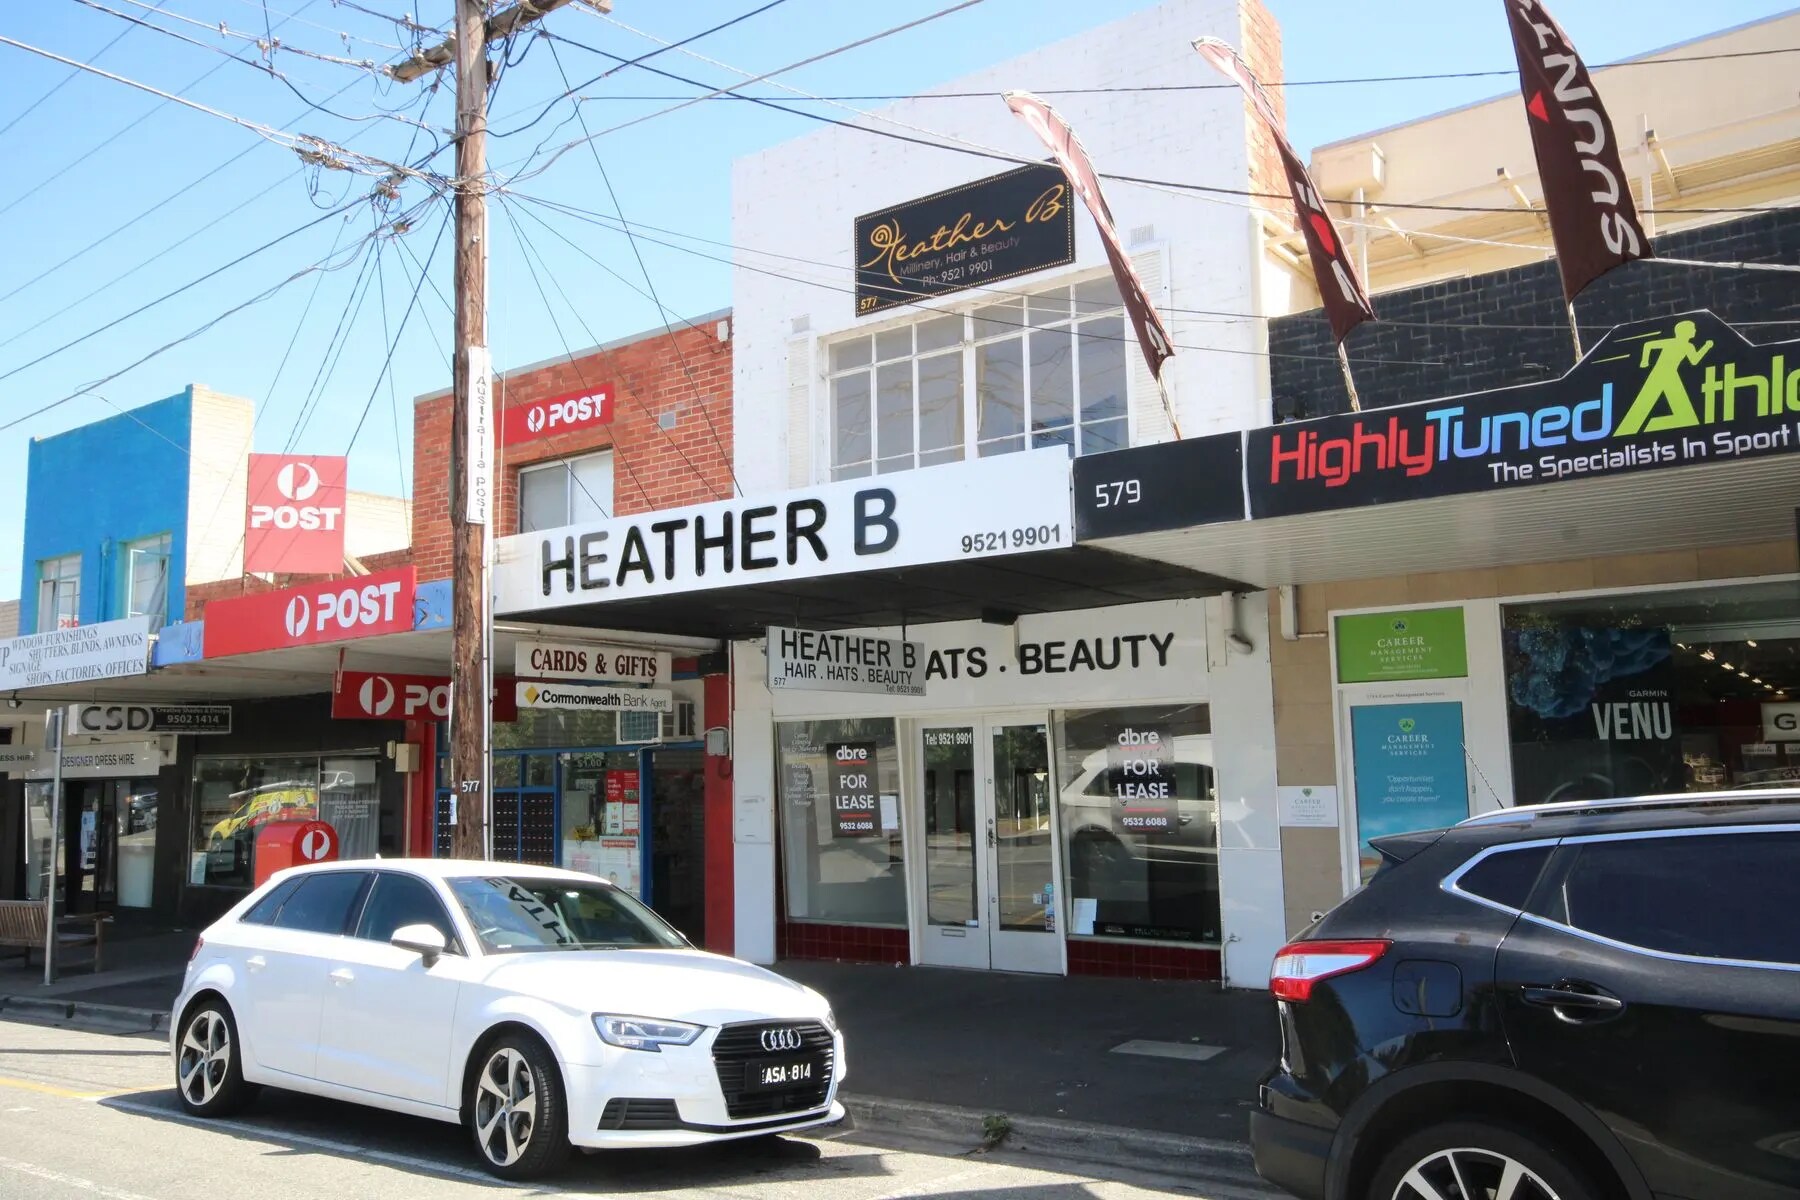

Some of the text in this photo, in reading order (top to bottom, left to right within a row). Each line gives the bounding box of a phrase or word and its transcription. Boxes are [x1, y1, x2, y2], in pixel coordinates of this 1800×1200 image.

[1518, 0, 1641, 257] SUUNT
[861, 184, 1066, 285] Heather B
[946, 249, 966, 265] Hair
[969, 246, 978, 257] &
[981, 236, 1020, 256] Beauty
[941, 268, 965, 282] 9521
[969, 260, 993, 276] 9901
[861, 297, 878, 310] 577
[549, 393, 606, 428] POST
[1488, 462, 1533, 483] The
[1539, 440, 1677, 478] Specialists
[1683, 437, 1707, 459] In
[1713, 424, 1790, 455] Sport
[1096, 479, 1141, 508] 579
[251, 505, 341, 531] POST
[542, 487, 900, 597] HEATHER B
[962, 523, 1061, 554] 9521 9901
[316, 581, 400, 632] POST
[12, 627, 98, 650] WINDOW FURNISHINGS
[103, 632, 143, 650] AWNINGS
[1377, 636, 1425, 648] CAREER
[781, 628, 917, 669] HEATHER B
[1019, 632, 1175, 675] BEAUTY
[1370, 647, 1433, 656] MANAGEMENT
[105, 659, 144, 676] OFFICES
[531, 648, 657, 677] CARDS & GIFTS
[1379, 655, 1424, 663] SERVICES
[9, 661, 41, 676] SIGNAGE
[784, 661, 913, 685] HAIR HATS BEAUTY
[774, 677, 786, 686] 577
[541, 689, 621, 707] Commonwealth
[623, 693, 648, 707] Bank
[81, 706, 150, 731] CSD
[167, 714, 219, 724] 9502 1414
[1591, 702, 1673, 740] VENU
[924, 732, 972, 745] Tel: 9521 9901
[1118, 728, 1160, 745] dbre
[1387, 734, 1429, 743] CAREER
[62, 754, 135, 767] DESIGNER DRESS HIRE
[836, 745, 867, 760] dbre
[1123, 759, 1160, 776] FOR
[462, 780, 480, 793] 577
[840, 774, 867, 789] FOR
[1117, 782, 1169, 799] LEASE
[836, 794, 875, 810] LEASE
[840, 822, 874, 830] 9532 6088
[1122, 817, 1168, 826] 9532 6088
